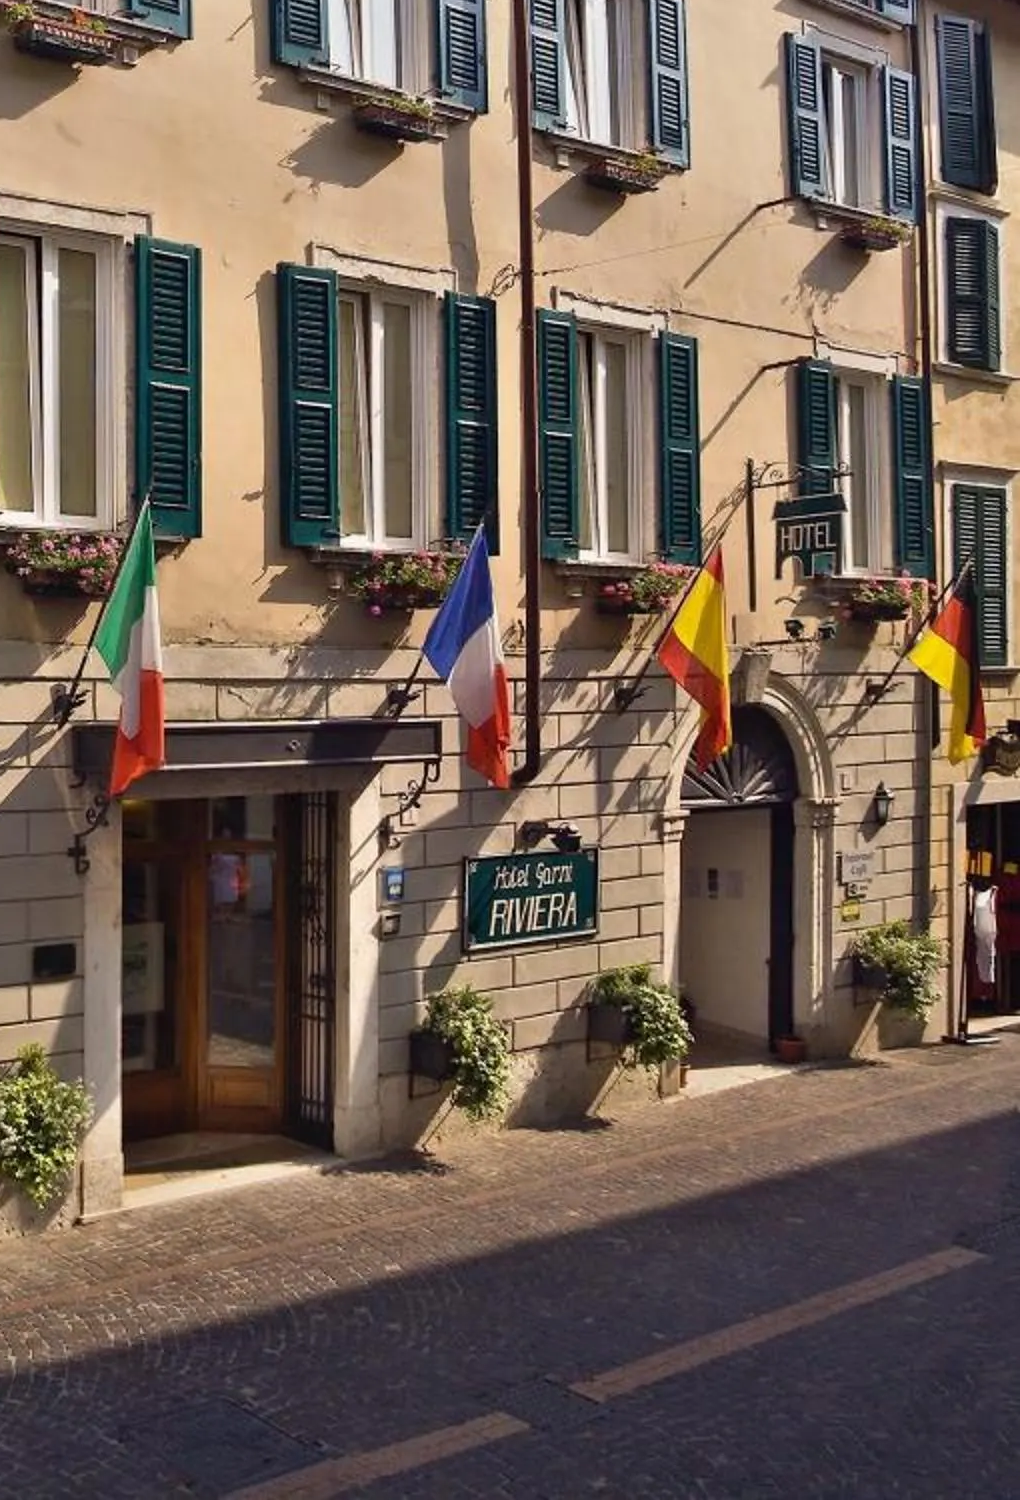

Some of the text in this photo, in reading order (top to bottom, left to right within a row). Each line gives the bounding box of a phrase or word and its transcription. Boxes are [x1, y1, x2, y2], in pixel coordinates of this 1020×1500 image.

[781, 522, 837, 551] HOTEL
[494, 864, 530, 890] Hotel
[489, 891, 577, 937] RIVIERA
